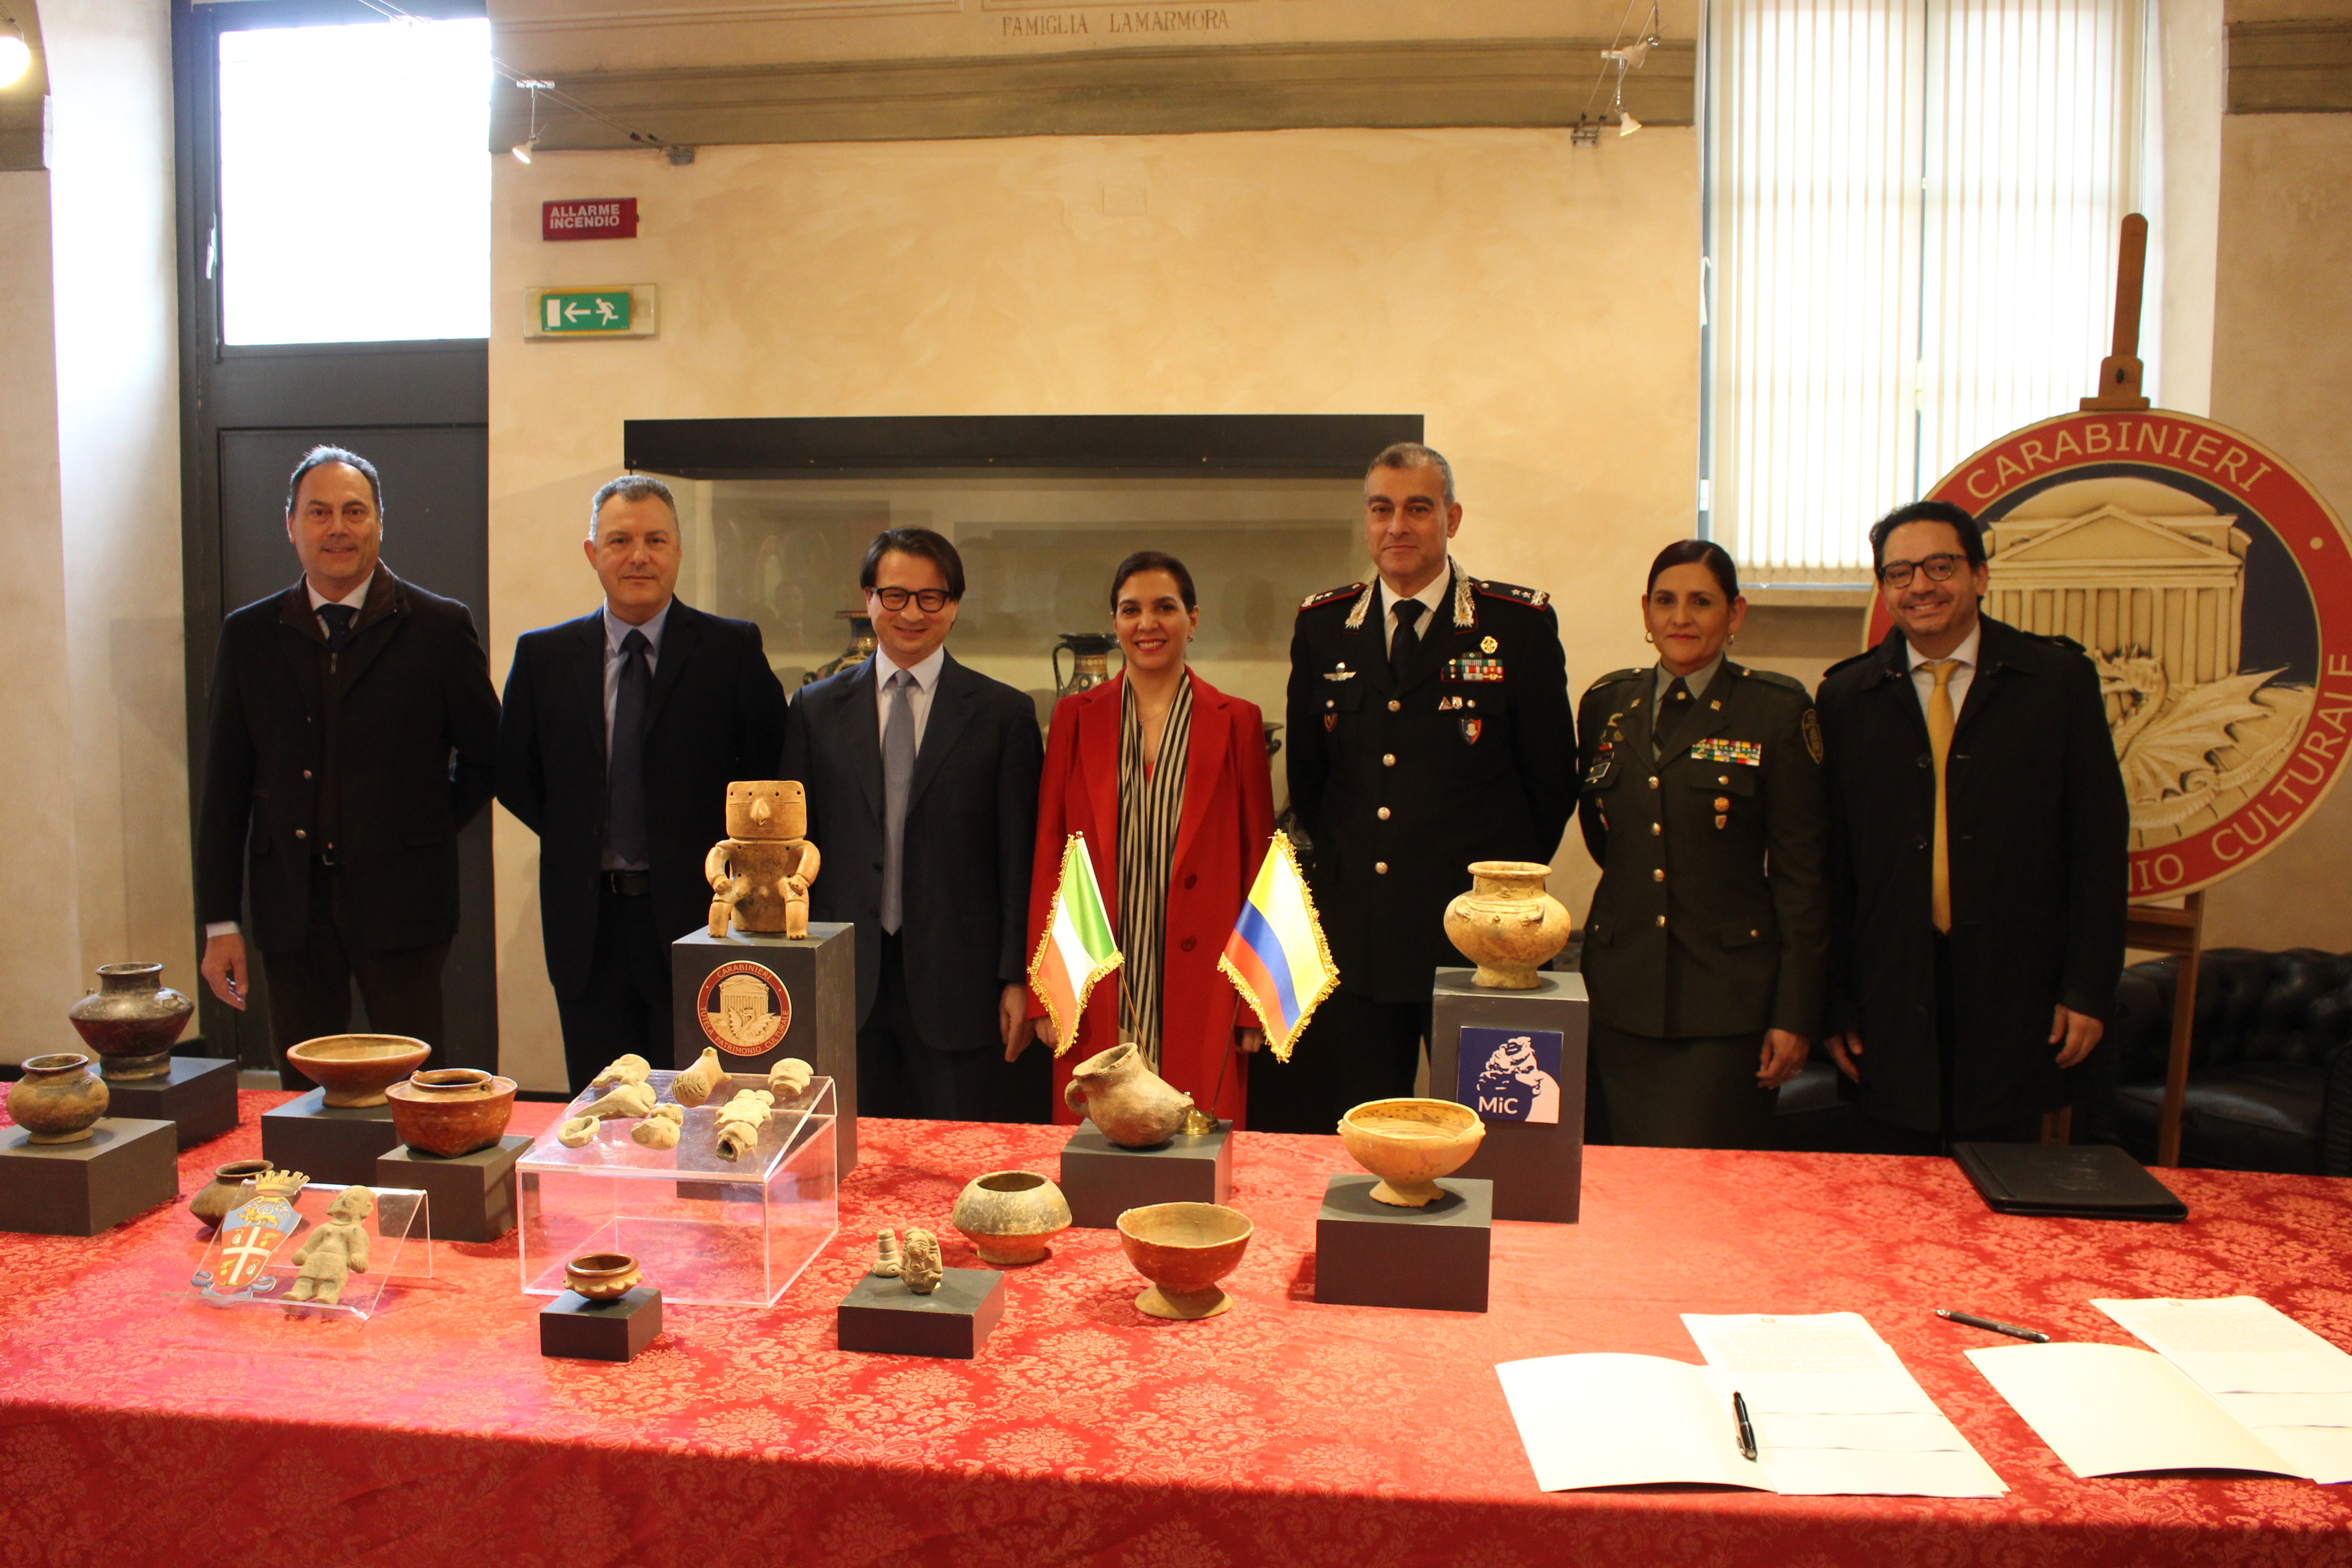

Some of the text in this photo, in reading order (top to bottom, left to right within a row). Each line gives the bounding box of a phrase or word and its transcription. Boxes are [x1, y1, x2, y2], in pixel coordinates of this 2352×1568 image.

[1002, 9, 1230, 37] FAMIGLIA LAMARMORA
[550, 204, 620, 217] ALLARME
[550, 215, 620, 229] INCENDIO
[1966, 421, 2271, 499] CARABINIERI
[717, 964, 772, 980] CARABINIERI
[700, 1007, 789, 1054] TUTELA PATRIMONIO CULTURALE
[1479, 1096, 1518, 1114] MiC
